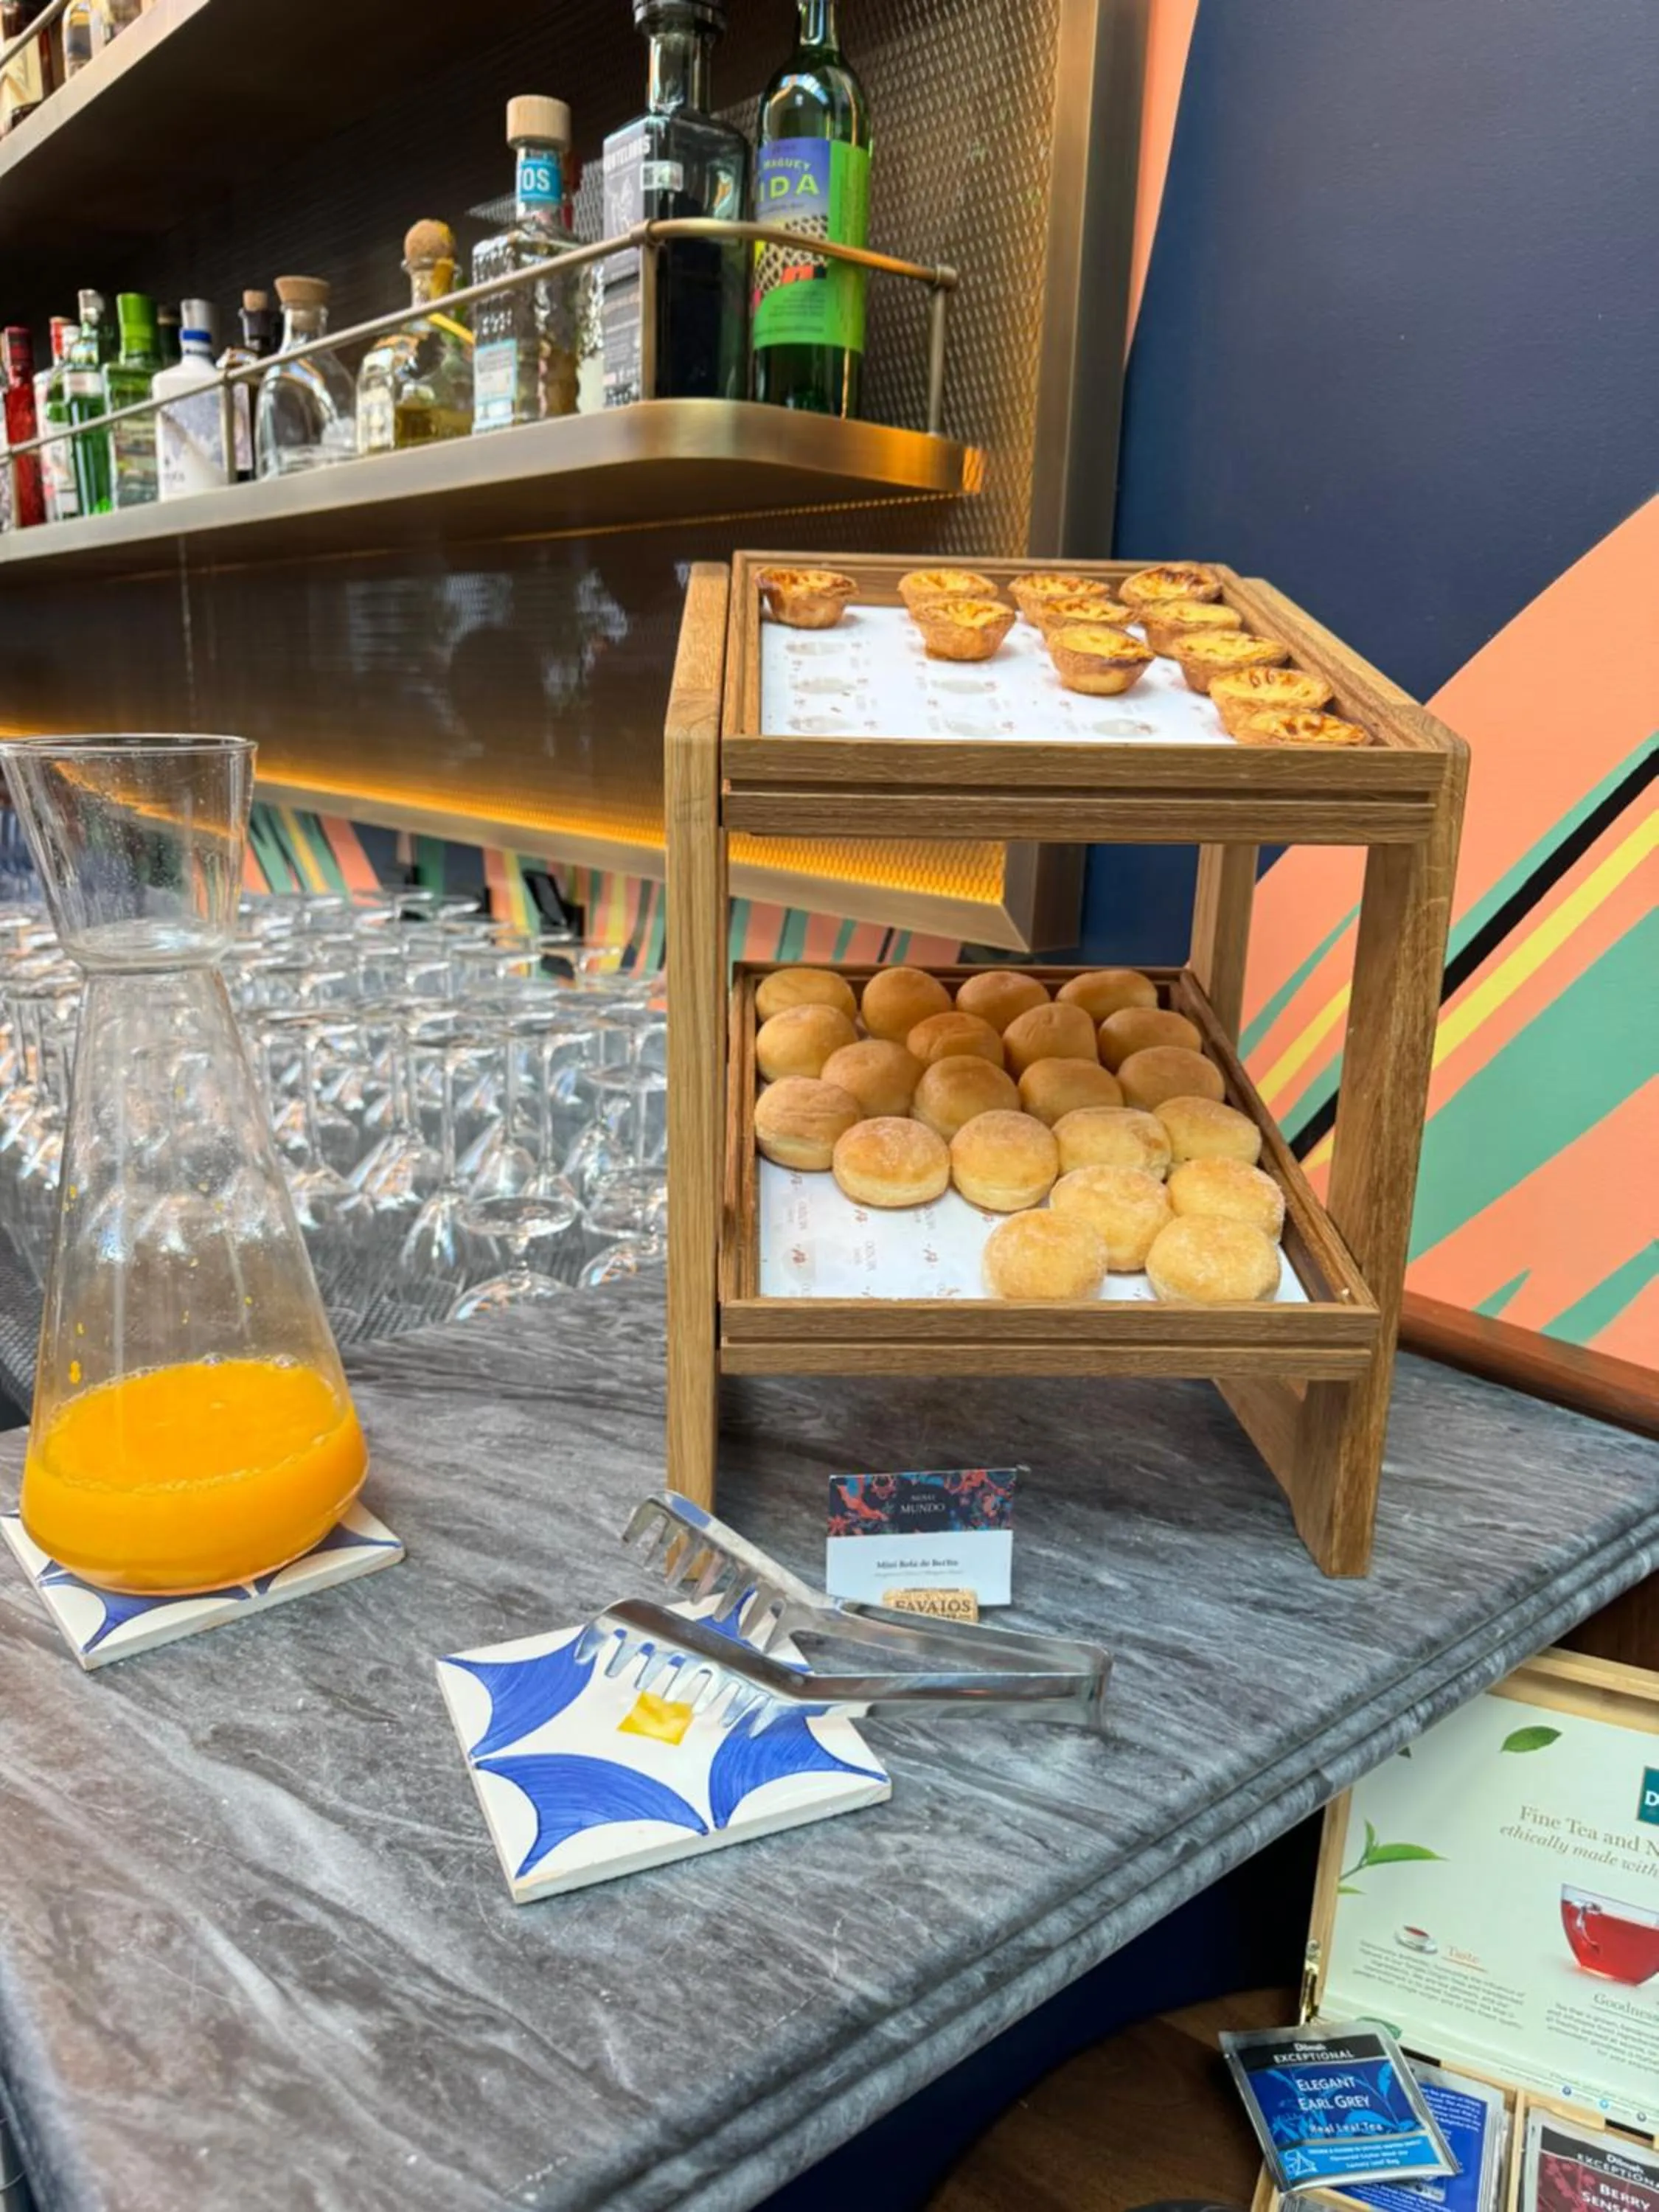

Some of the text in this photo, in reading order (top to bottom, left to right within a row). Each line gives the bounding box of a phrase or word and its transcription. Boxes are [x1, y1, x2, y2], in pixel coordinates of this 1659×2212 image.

[1520, 1805, 1562, 1830] Fine
[1565, 1817, 1598, 1841] Tea
[1603, 1833, 1641, 1852] and
[1500, 1826, 1570, 1854] ethically
[1572, 1846, 1618, 1866] made
[1273, 2050, 1354, 2065] EXCEPTIONAL
[1296, 2076, 1356, 2092] ELEGANT
[1298, 2095, 1371, 2112] EARL GREY
[1360, 2121, 1384, 2132] Tea
[1599, 2183, 1650, 2211] BERRY
